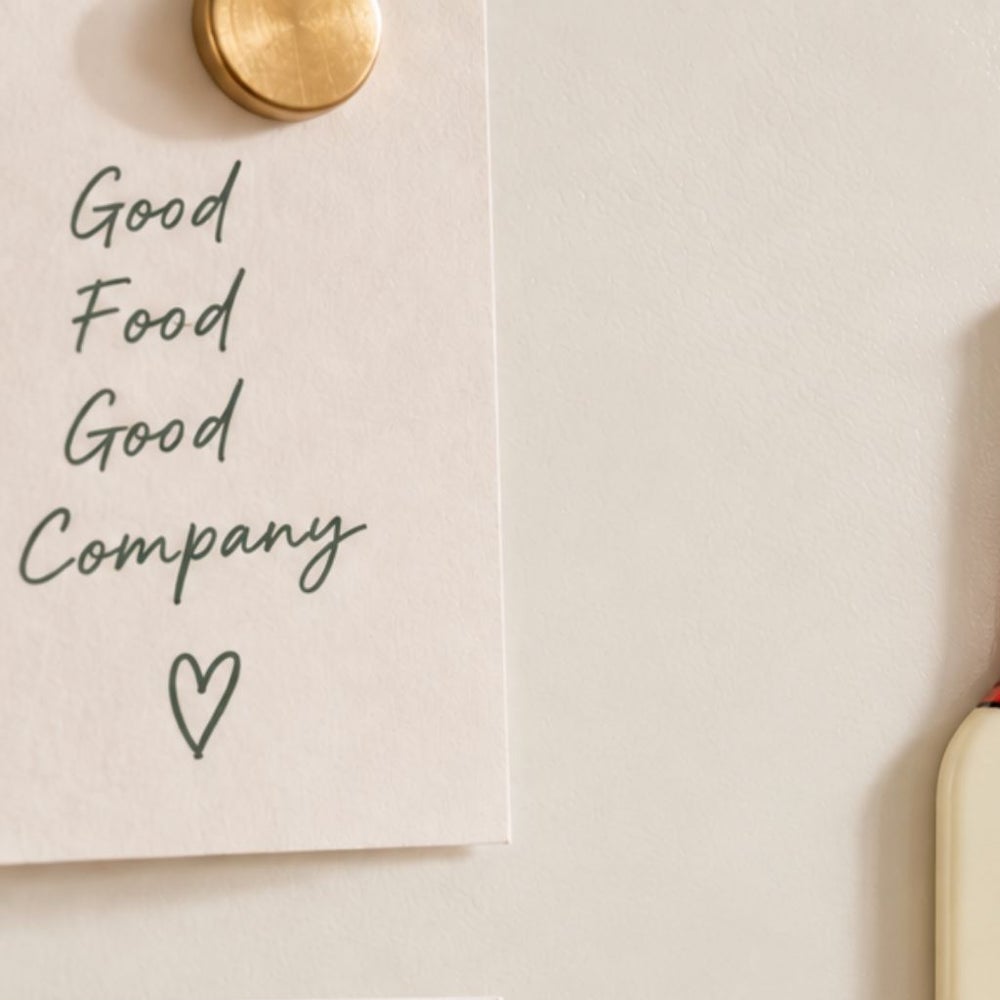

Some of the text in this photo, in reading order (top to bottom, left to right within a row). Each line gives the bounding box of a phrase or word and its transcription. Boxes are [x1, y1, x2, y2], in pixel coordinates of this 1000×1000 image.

[70, 159, 242, 249] Good
[71, 267, 246, 353] Food
[64, 378, 244, 472] Good
[19, 507, 368, 606] Company
